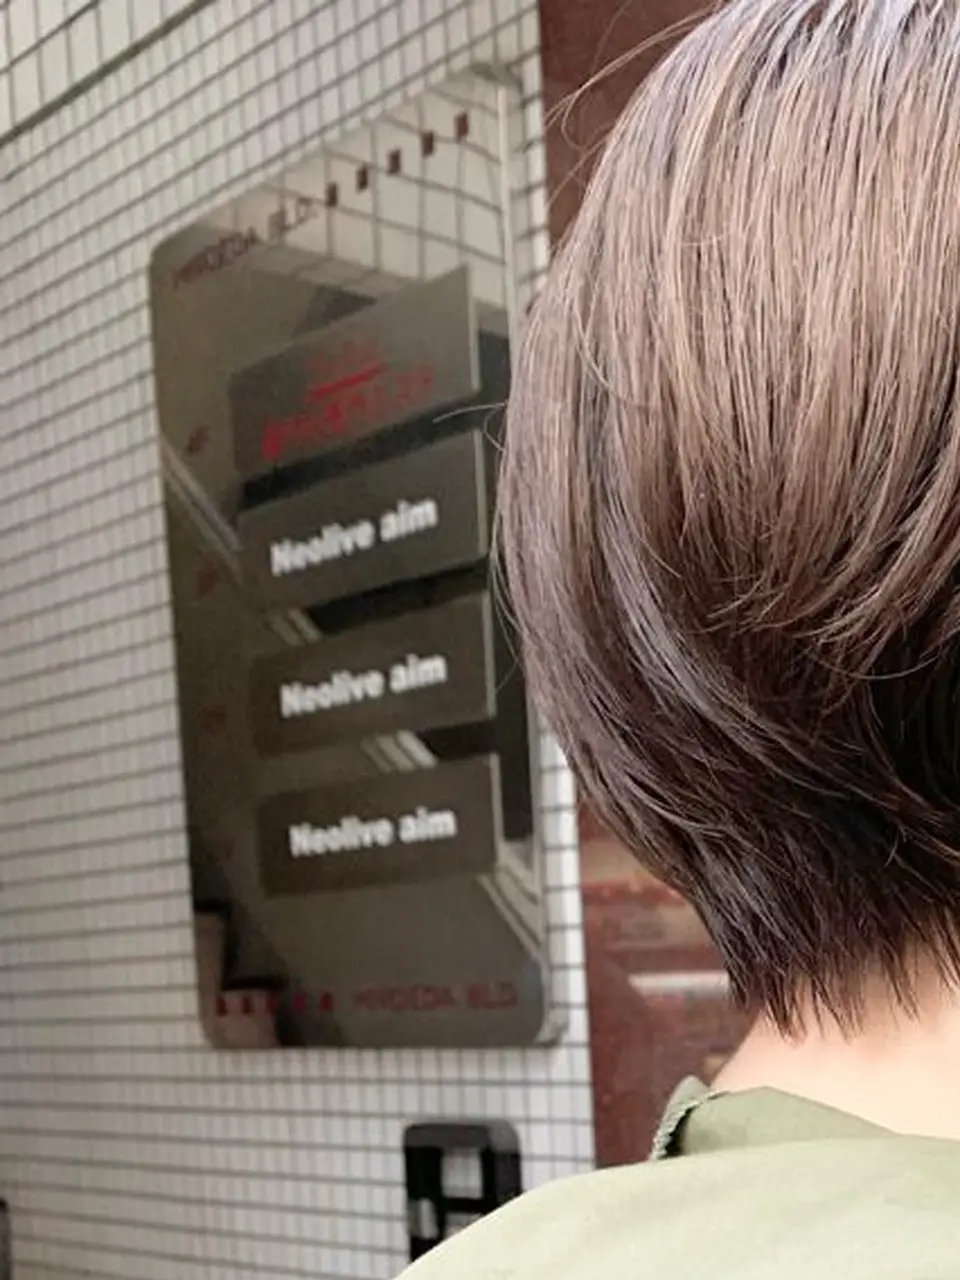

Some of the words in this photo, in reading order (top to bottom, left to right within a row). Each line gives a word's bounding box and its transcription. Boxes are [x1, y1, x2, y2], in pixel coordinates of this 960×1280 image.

[380, 497, 439, 542] aim
[389, 652, 448, 694] aim
[399, 805, 458, 844] aim
